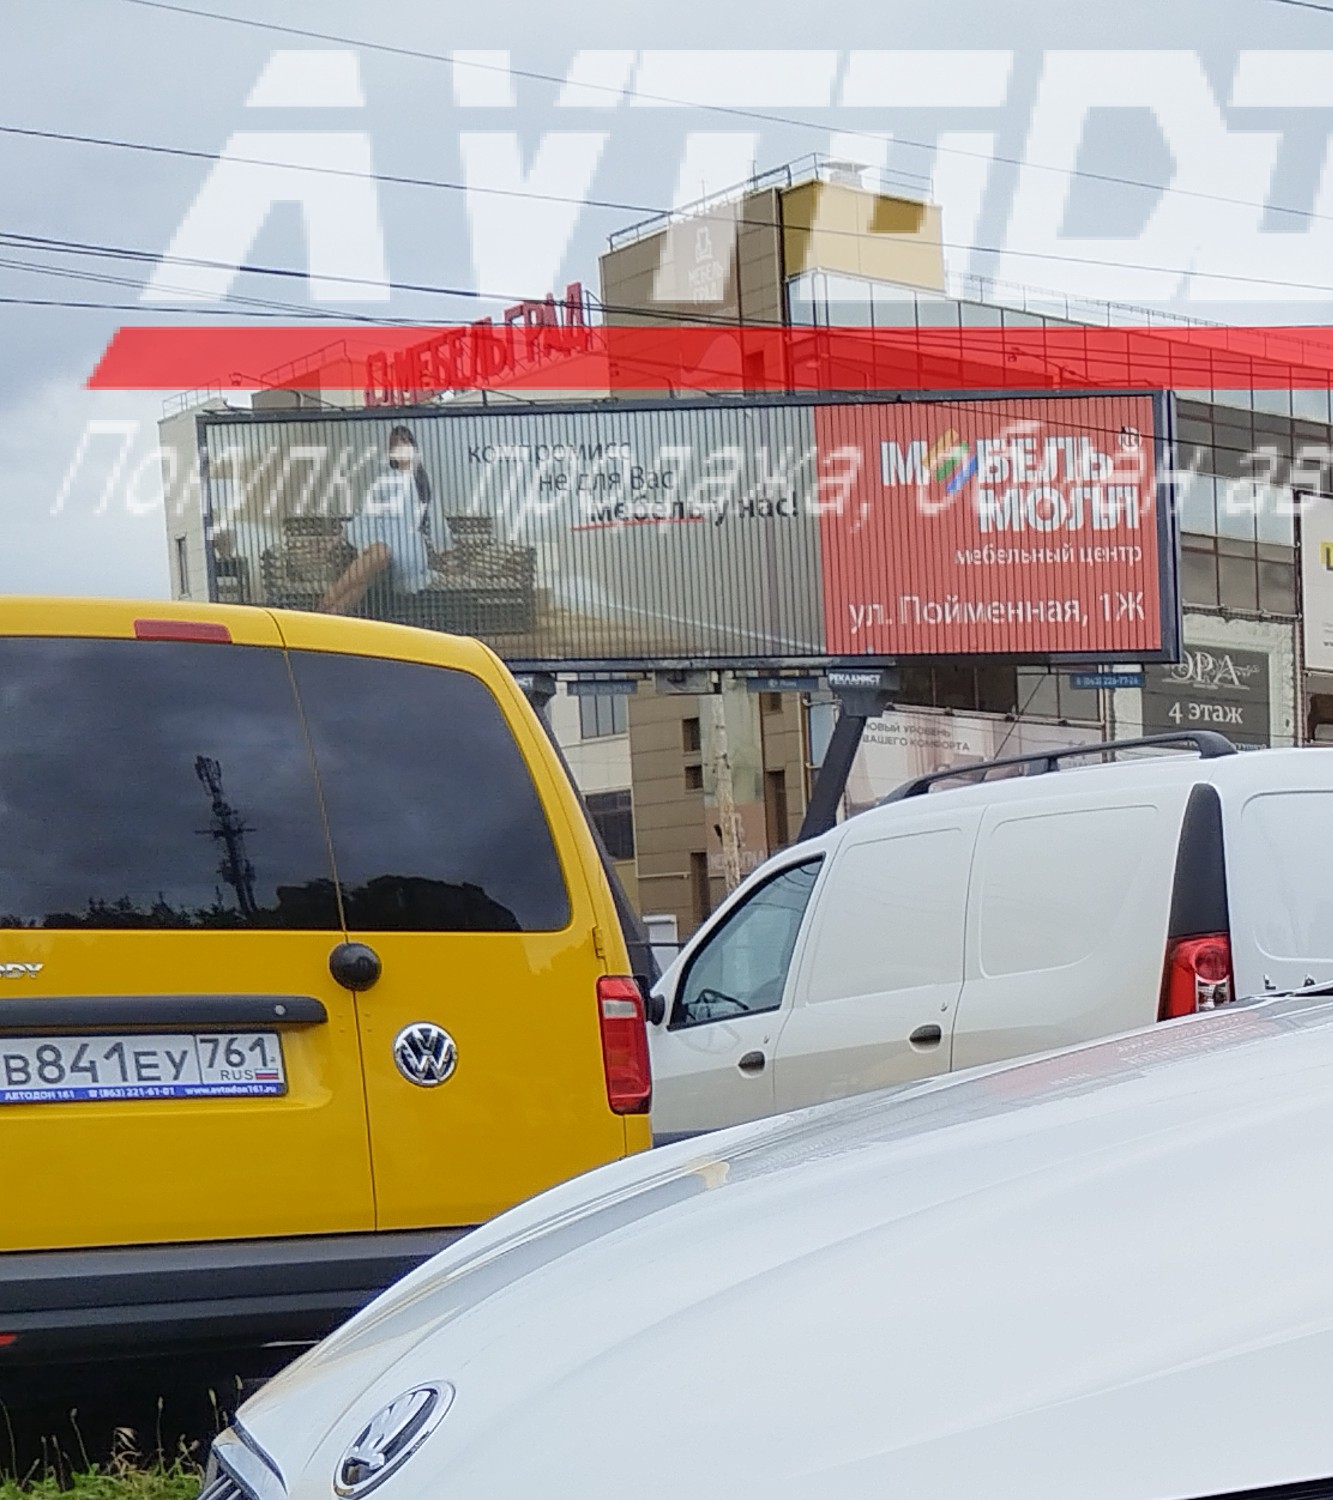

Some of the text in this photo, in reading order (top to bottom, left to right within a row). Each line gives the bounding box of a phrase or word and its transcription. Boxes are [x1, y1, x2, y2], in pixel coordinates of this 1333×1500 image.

[468, 440, 631, 464] компромисс
[539, 471, 568, 492] не
[630, 465, 674, 491] Вас
[712, 500, 729, 527] у
[738, 491, 799, 519] нас!
[978, 485, 1141, 533] МОЛЛ
[955, 543, 1143, 567] мебельный центр
[849, 591, 1146, 634] ул. Пойменная, 1Ж
[1168, 702, 1244, 725] 4 этаж
[200, 1036, 269, 1069] 761
[221, 1069, 255, 1082] RUS
